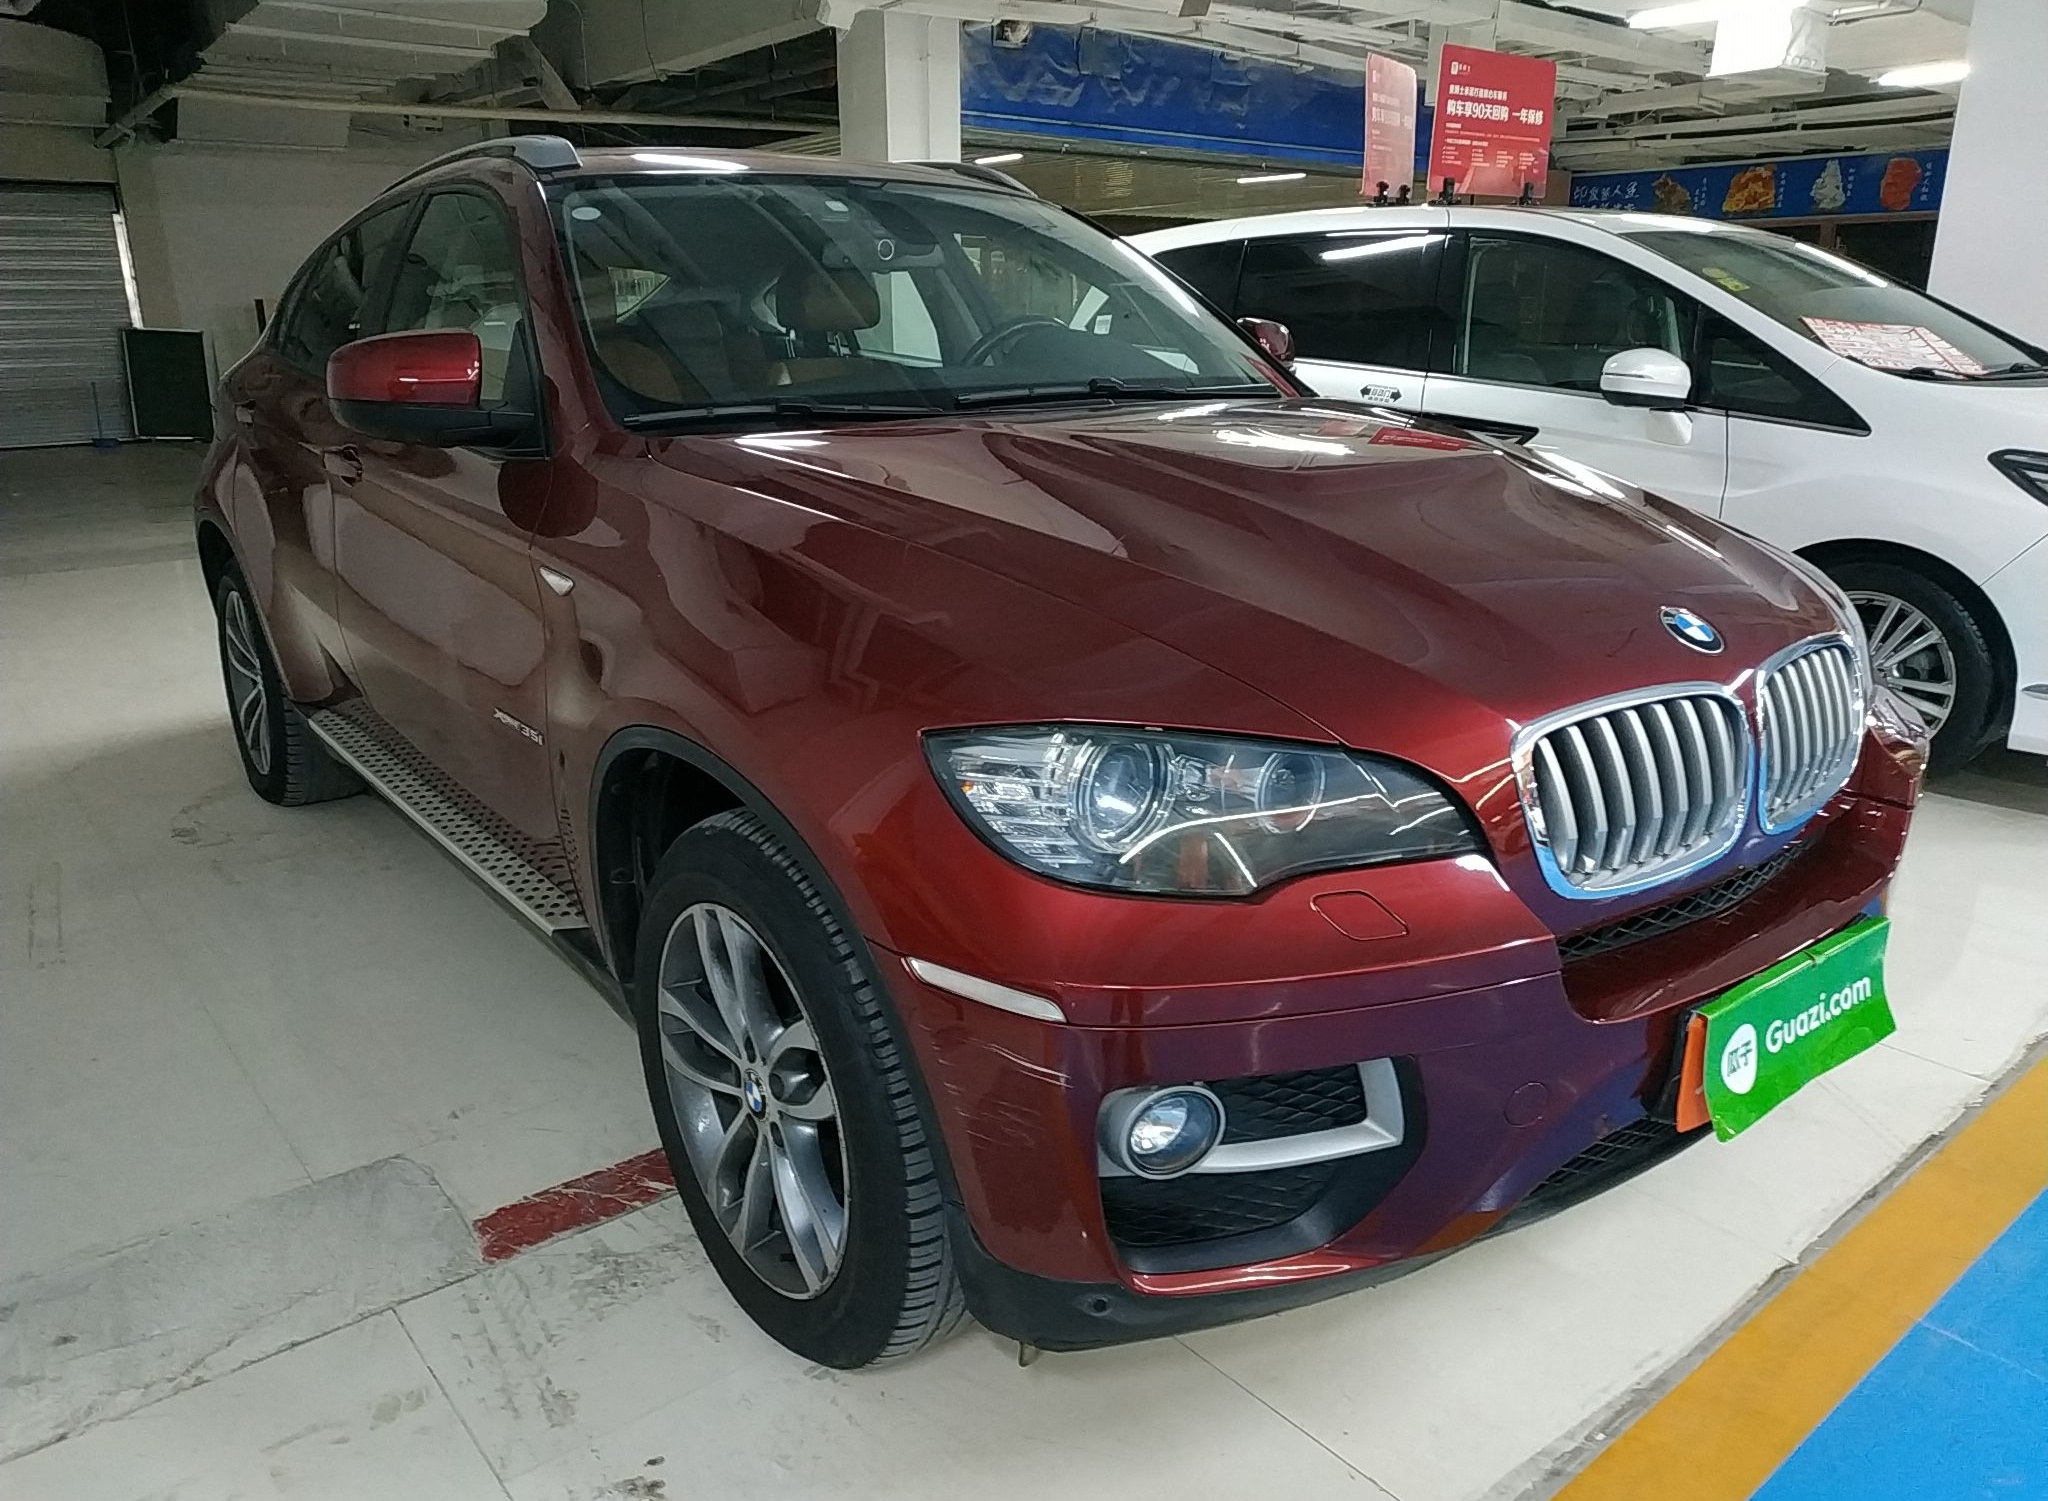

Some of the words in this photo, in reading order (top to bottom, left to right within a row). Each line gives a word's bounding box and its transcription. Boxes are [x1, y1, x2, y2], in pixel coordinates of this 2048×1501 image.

[1446, 98, 1509, 122] 购车享90天回购
[1511, 107, 1544, 126] 一年保修
[1765, 976, 1872, 1053] Guazi.com
